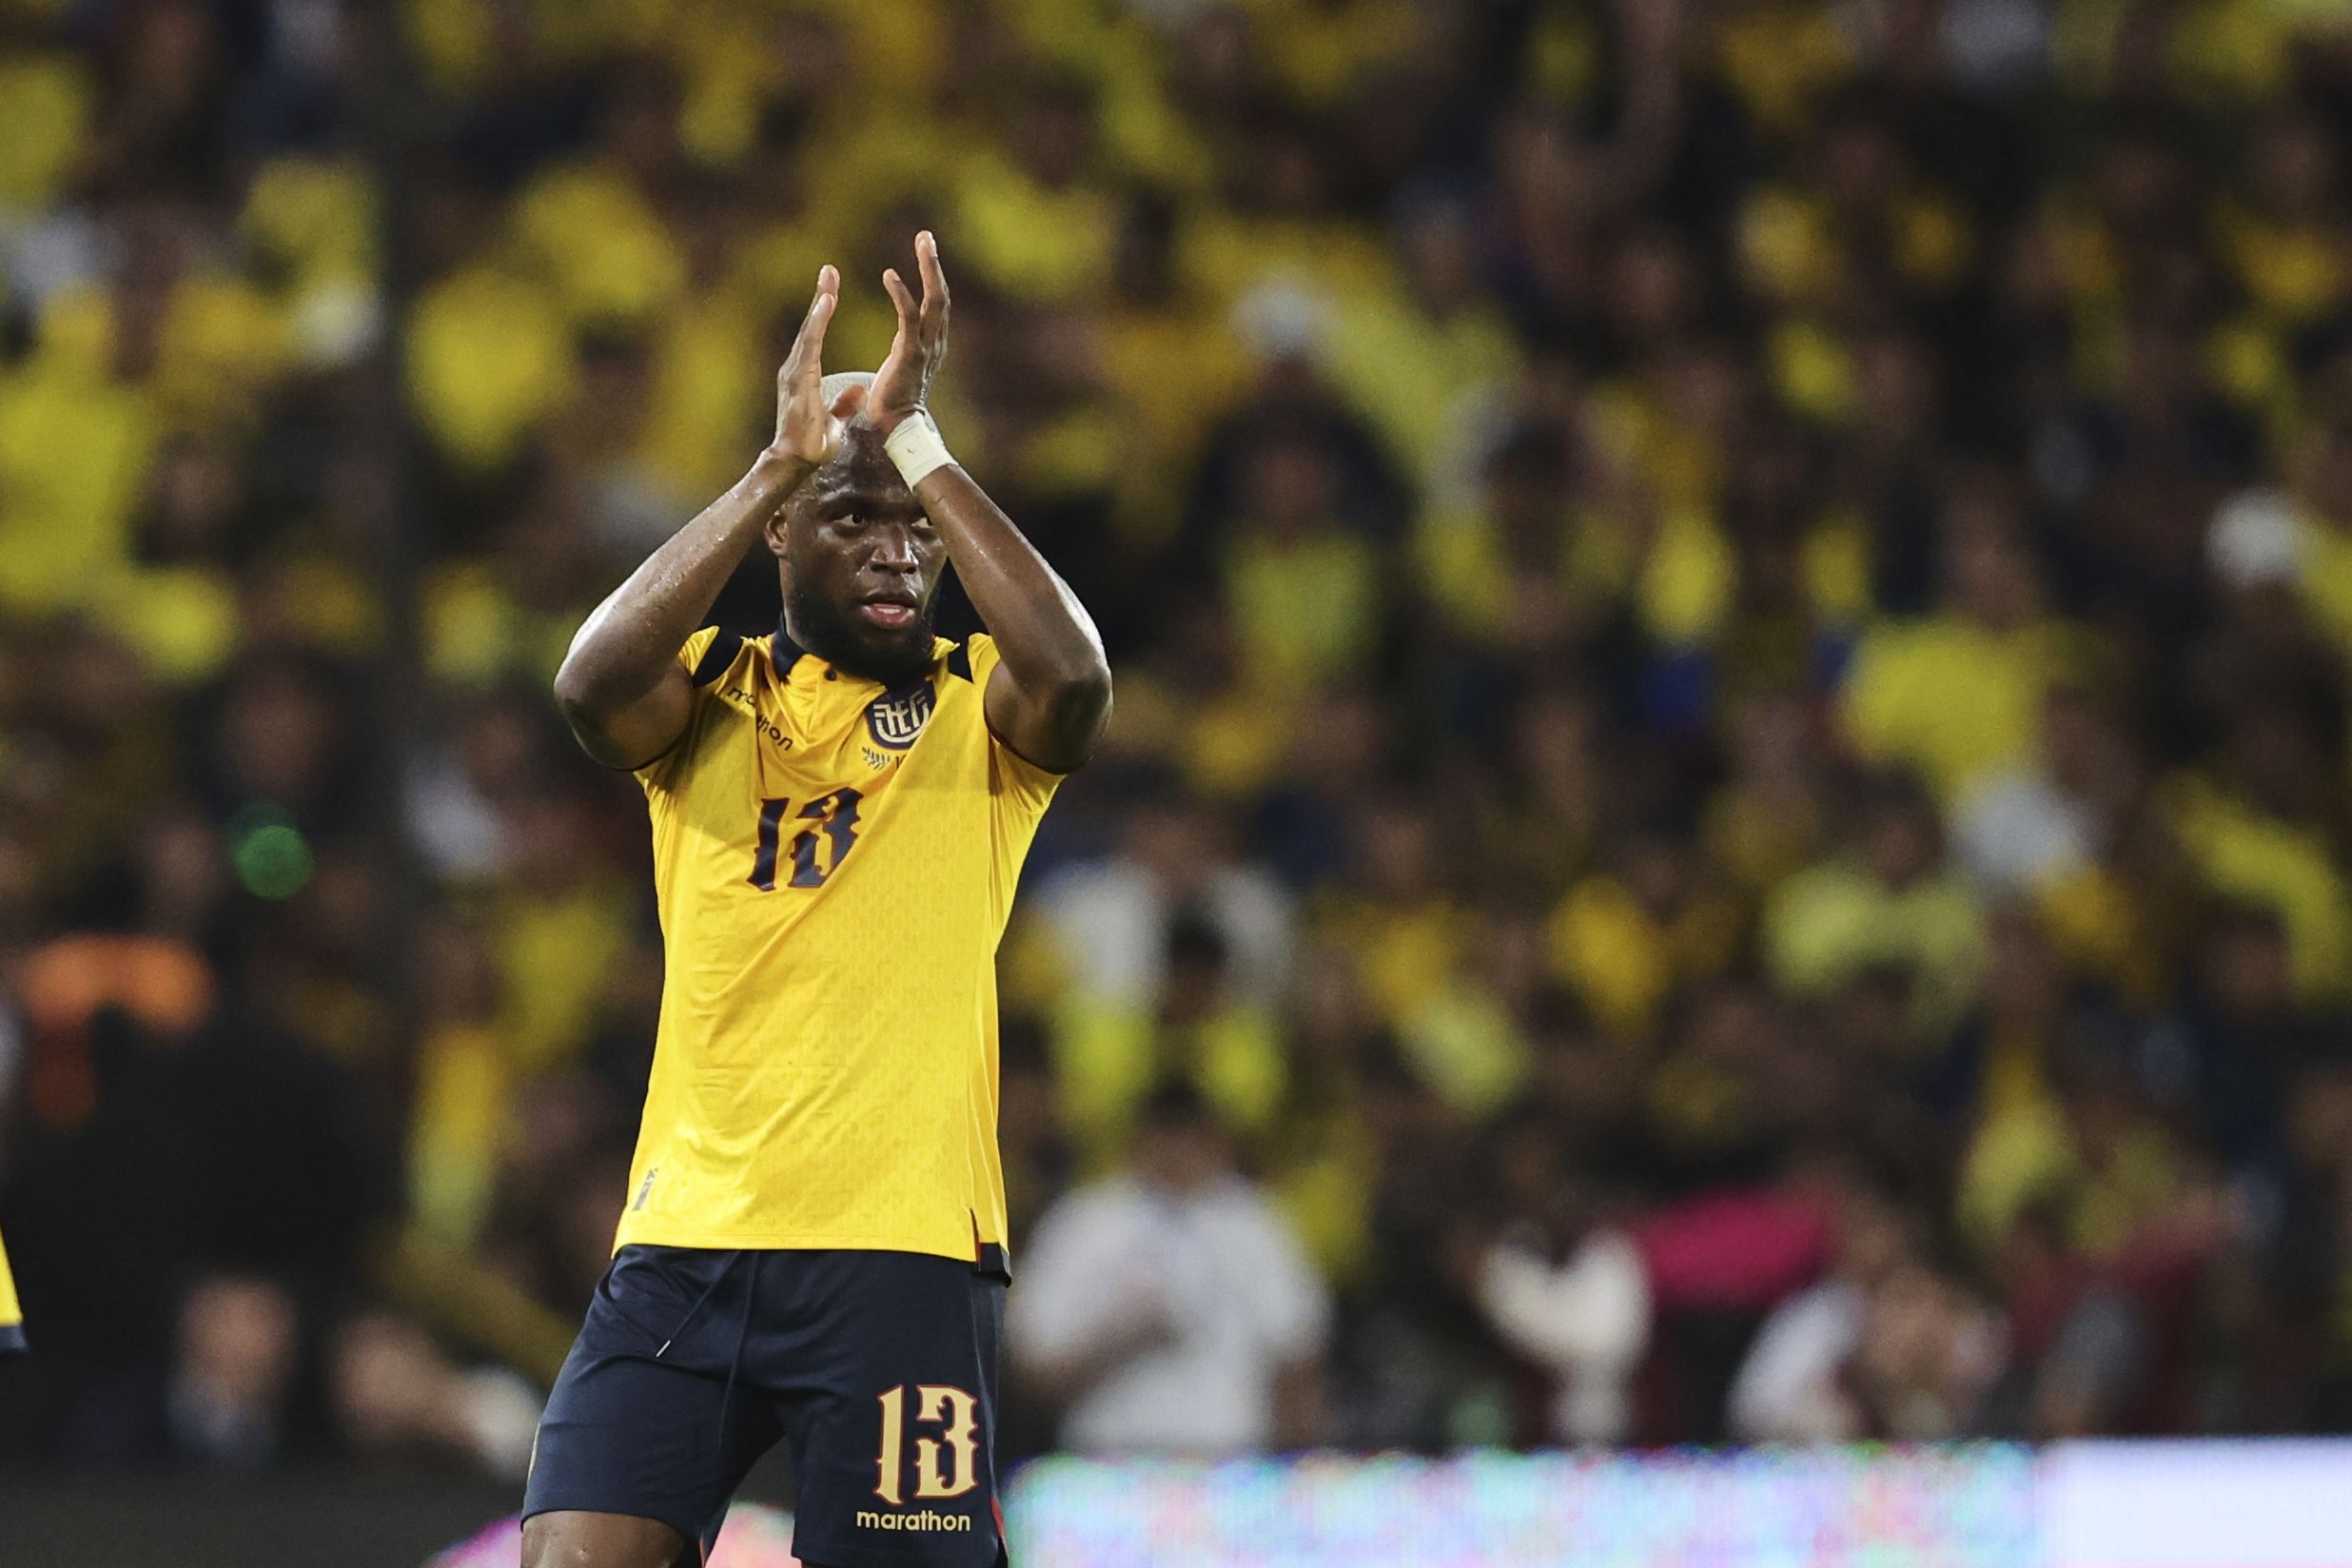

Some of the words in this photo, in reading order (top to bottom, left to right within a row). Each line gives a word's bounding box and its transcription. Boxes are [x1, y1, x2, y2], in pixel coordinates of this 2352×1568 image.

[727, 686, 794, 751] mahon
[747, 786, 865, 892] 13
[872, 1384, 980, 1506] 13
[856, 1510, 971, 1531] marathon
